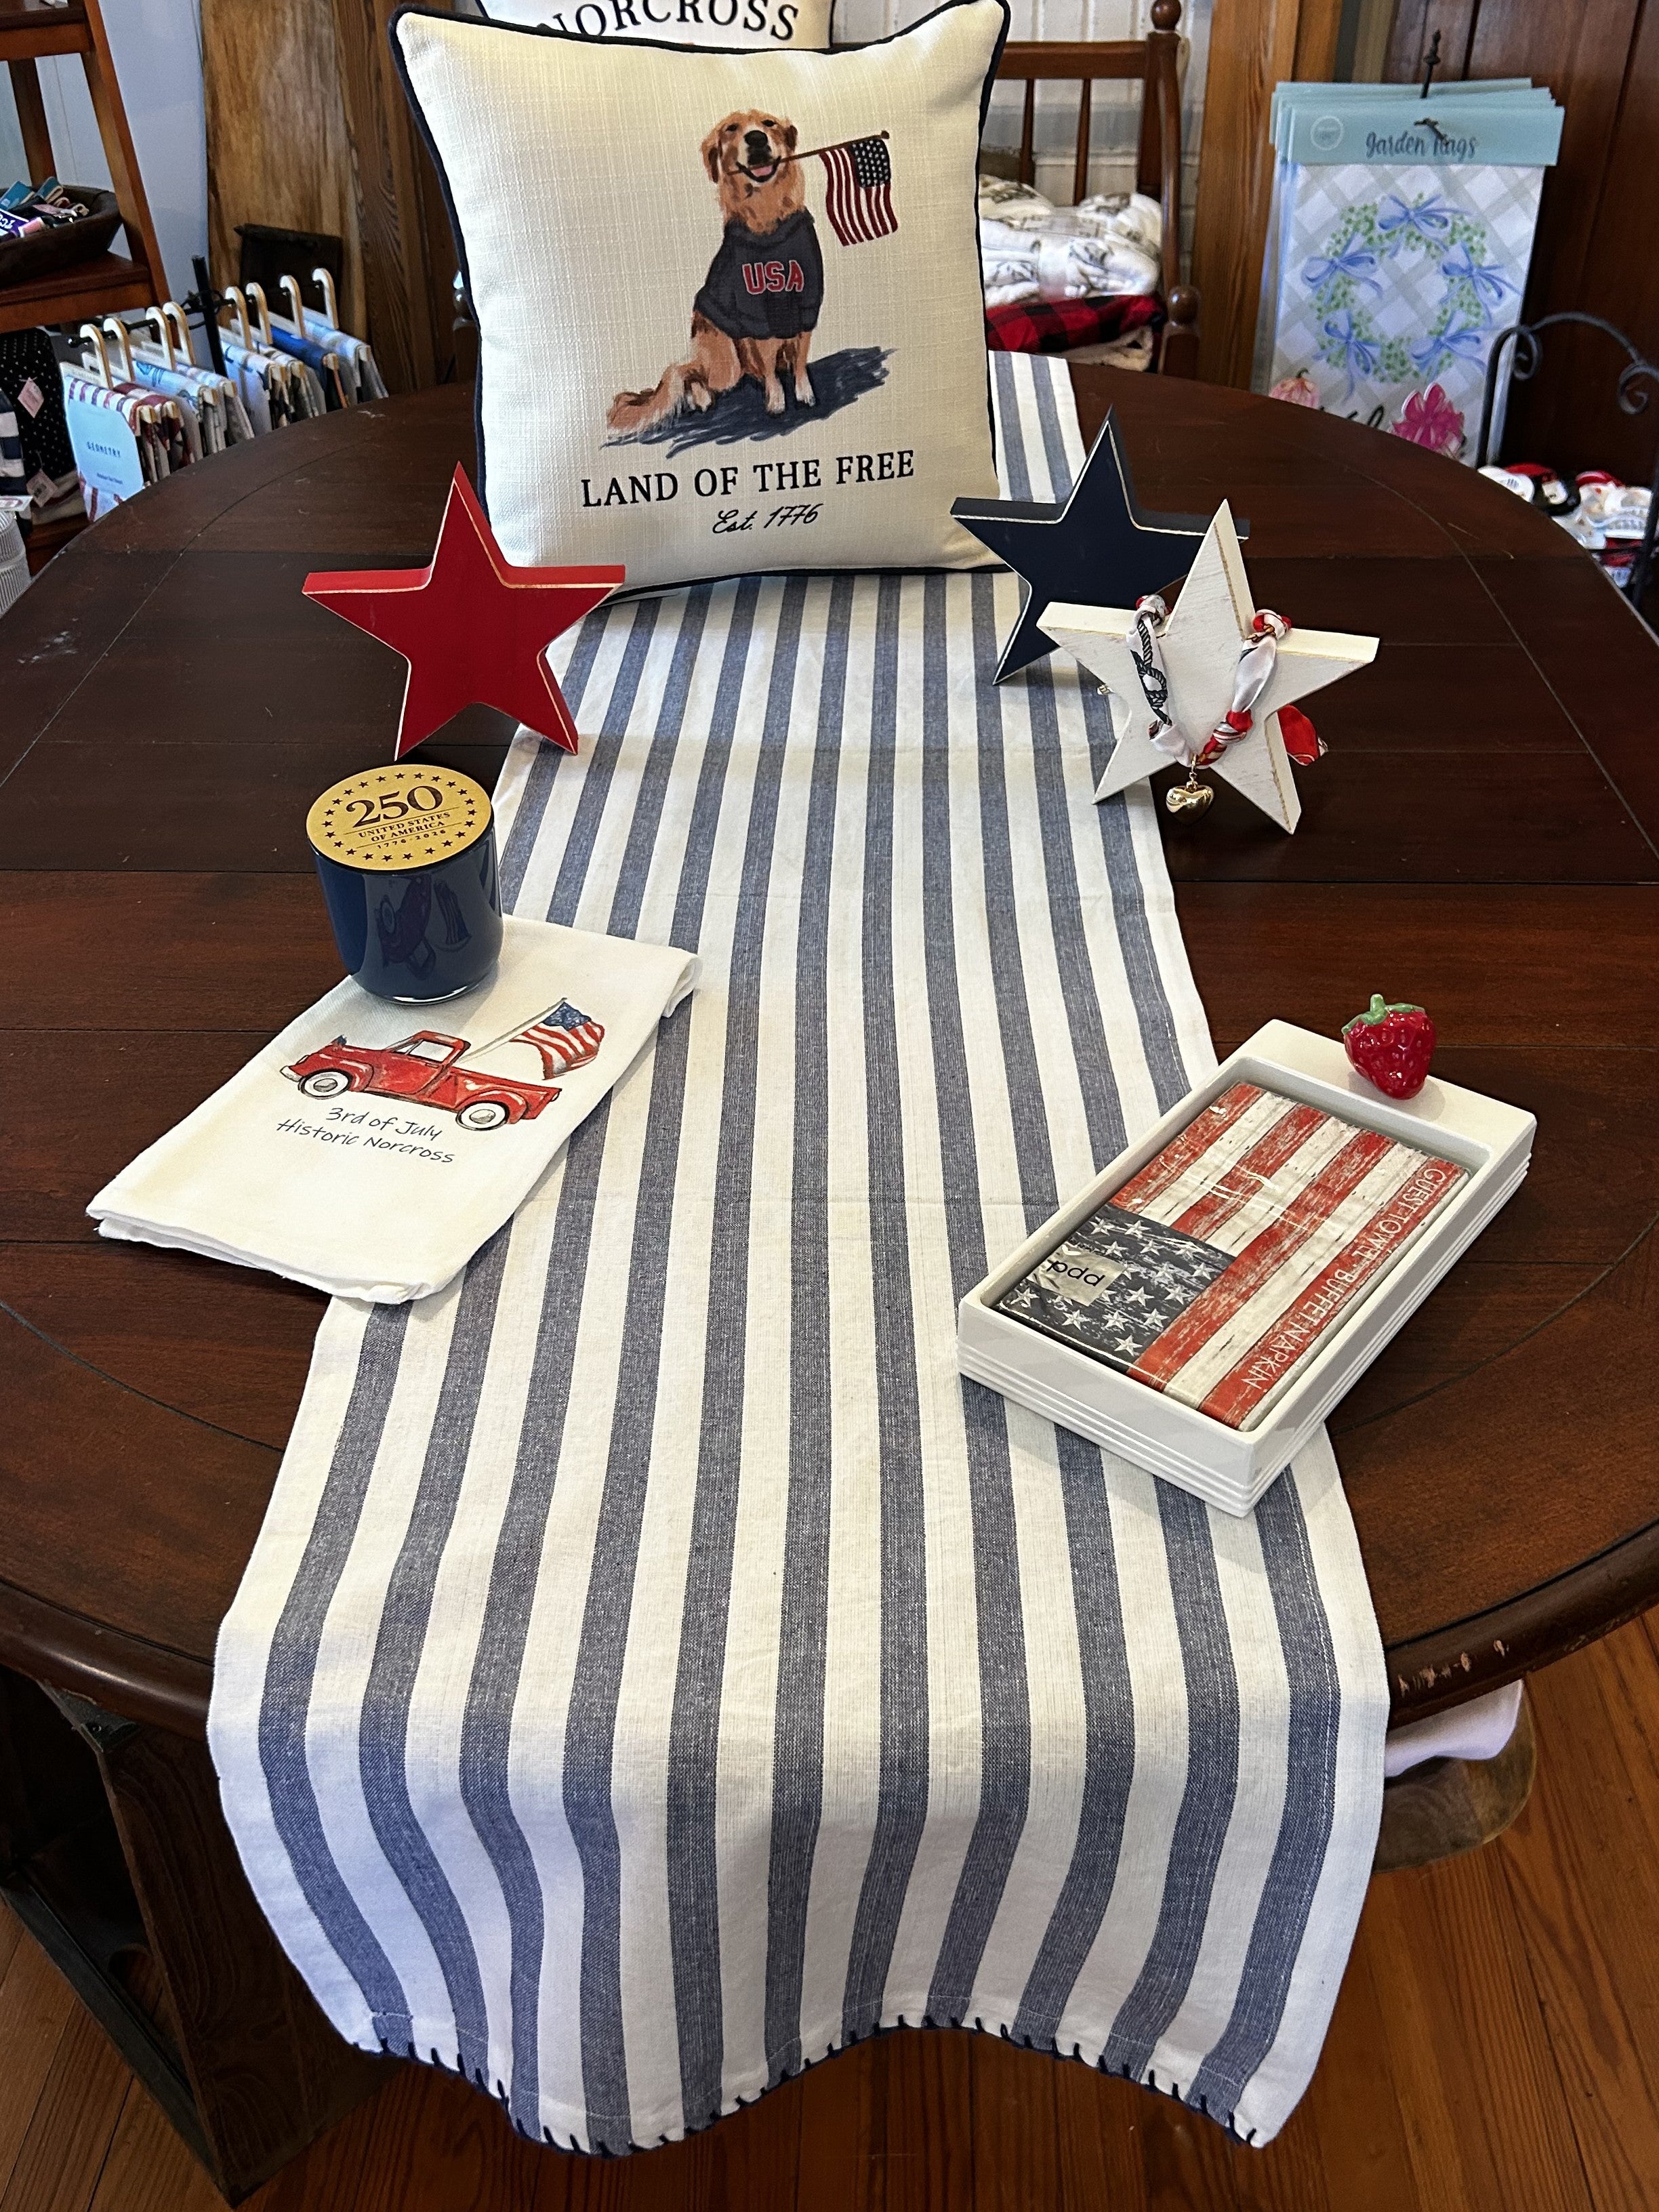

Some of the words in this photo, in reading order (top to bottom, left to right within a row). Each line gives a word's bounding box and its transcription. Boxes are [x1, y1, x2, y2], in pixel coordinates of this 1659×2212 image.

[552, 0, 799, 41] ORCROSS
[1366, 129, 1426, 159] garden
[741, 260, 804, 295] USA
[581, 472, 678, 508] LAND
[694, 466, 739, 497] OF
[753, 459, 822, 493] THE
[836, 449, 914, 485] FREE
[712, 509, 758, 534] Est.
[763, 503, 825, 529] 1776
[346, 785, 443, 828] 250
[358, 823, 405, 838] UNITED
[407, 812, 451, 827] STATES
[371, 834, 386, 842] OF
[390, 821, 445, 838] AMERICA
[276, 1119, 359, 1145] Historic
[363, 1136, 456, 1164] Norcross
[325, 1107, 370, 1124] 3rd
[368, 1117, 398, 1131] of
[395, 1121, 443, 1141] July
[1397, 1168, 1447, 1213] GUEST
[1351, 1213, 1408, 1263] TOWEL
[1295, 1268, 1357, 1327] BUFFET
[1241, 1322, 1311, 1390] NAPKIN
